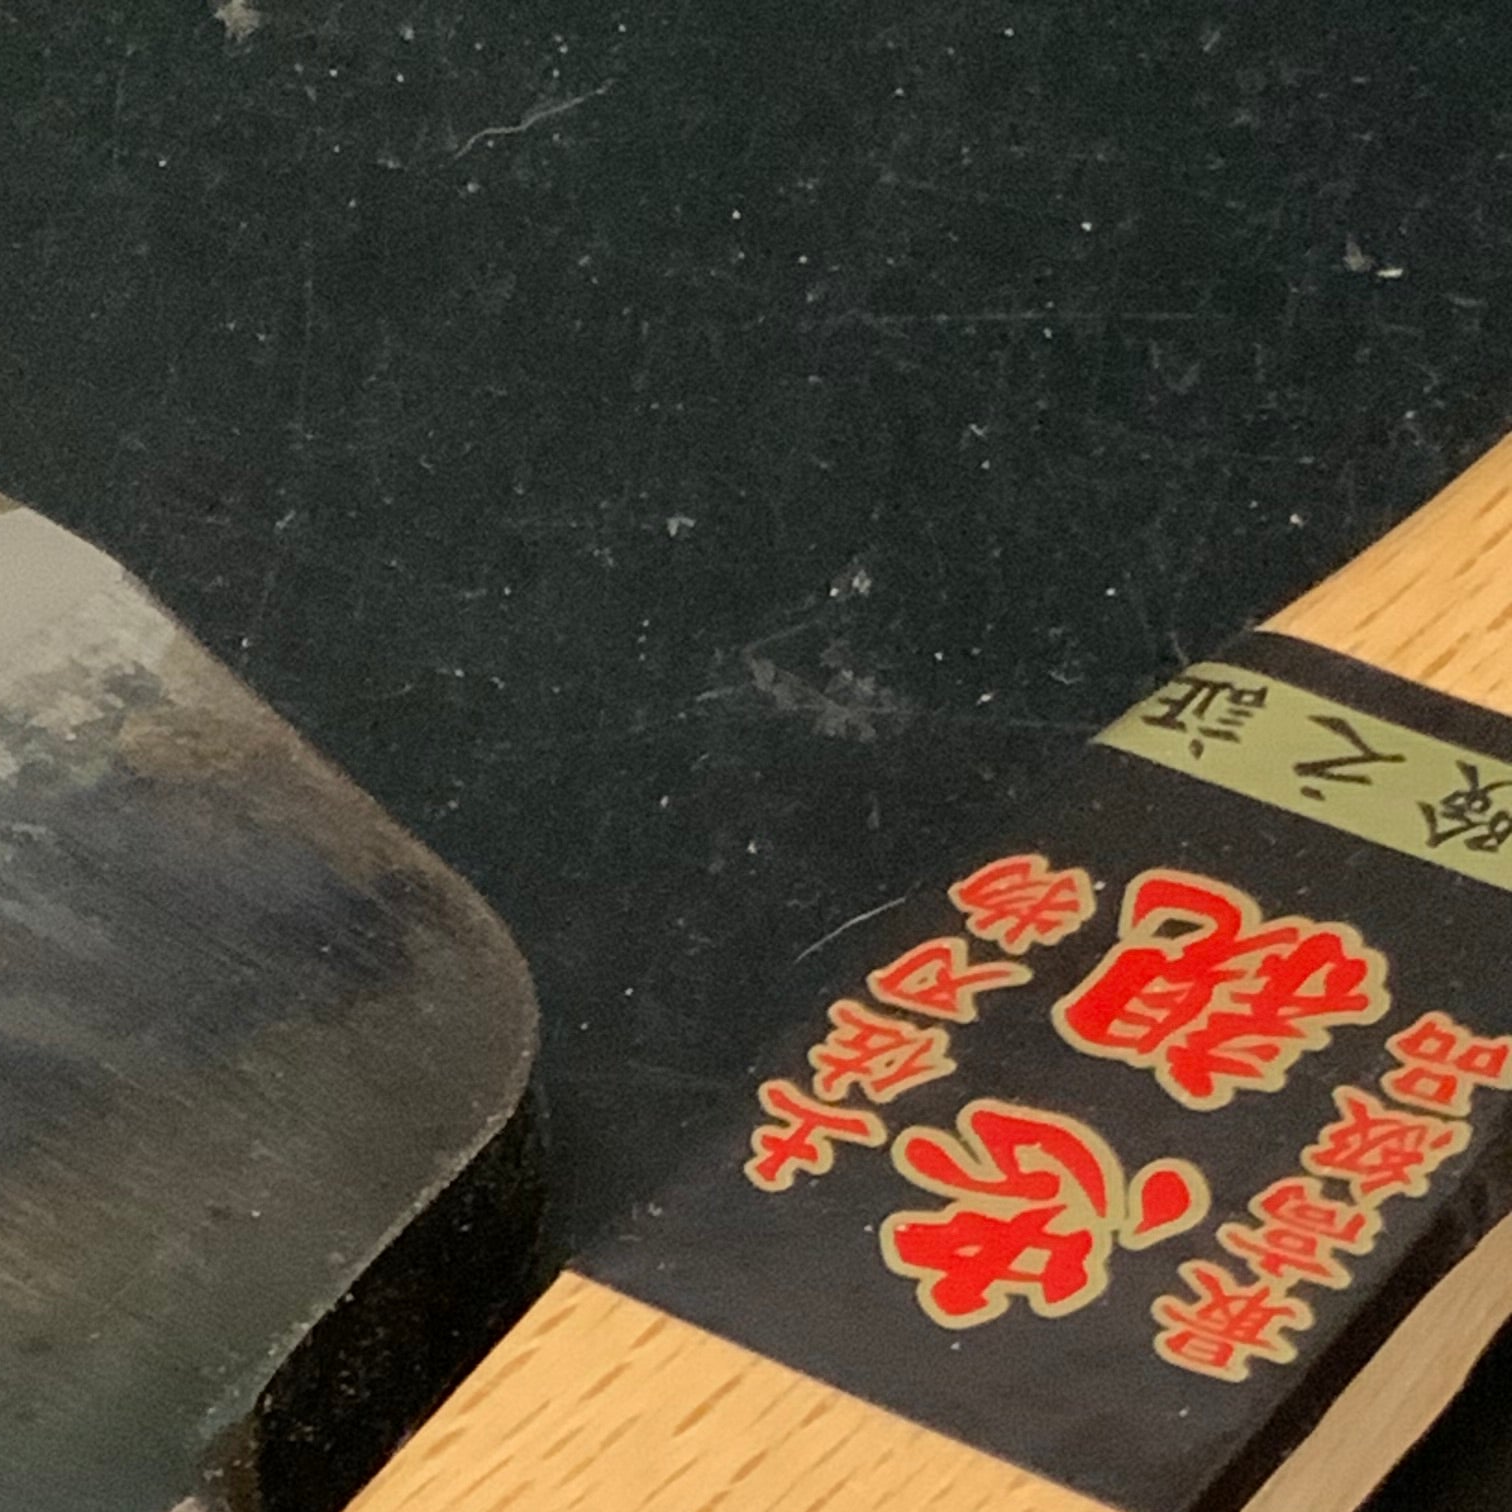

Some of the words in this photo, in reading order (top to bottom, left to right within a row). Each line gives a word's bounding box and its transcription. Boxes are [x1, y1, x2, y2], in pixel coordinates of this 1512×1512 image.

[745, 854, 1095, 1190] 土佐刃物
[880, 868, 1390, 1329] 忠親
[1151, 1011, 1512, 1382] 最高級品
